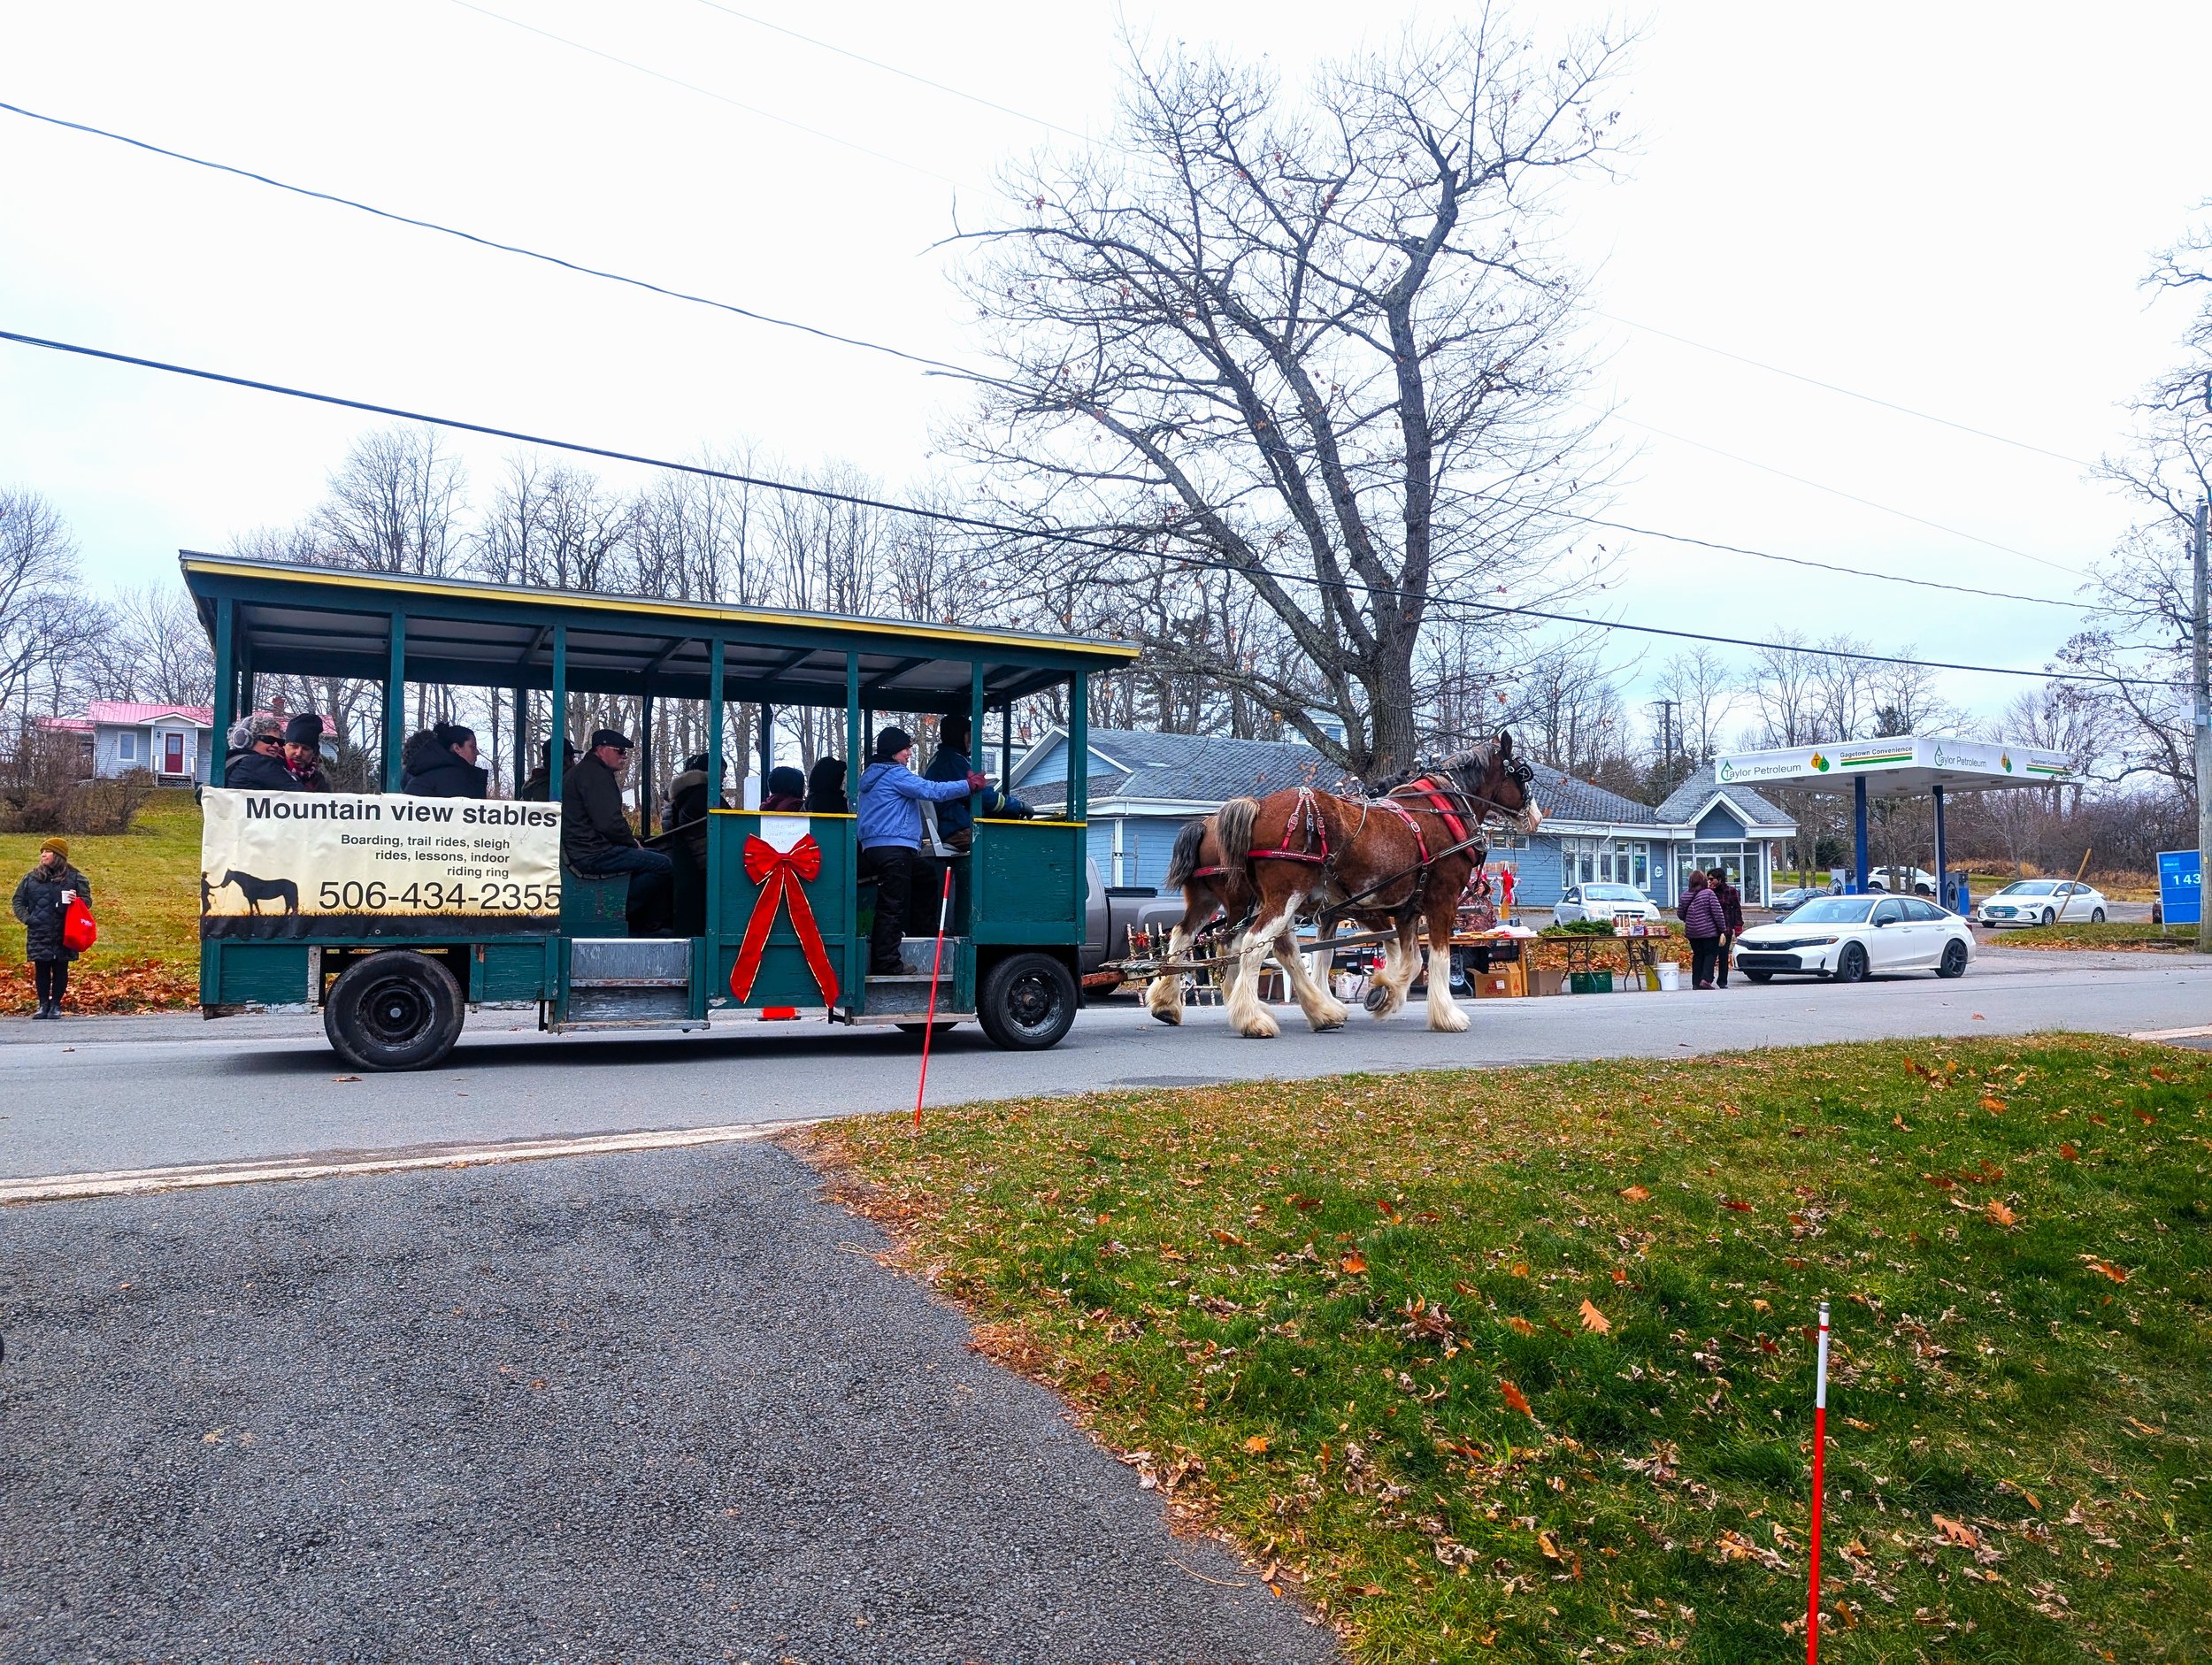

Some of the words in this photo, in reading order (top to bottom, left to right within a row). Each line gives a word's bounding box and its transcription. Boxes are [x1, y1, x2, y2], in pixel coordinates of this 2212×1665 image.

[1839, 750, 1870, 759] Gagetown
[1871, 746, 1913, 755] Convenience
[1937, 754, 1955, 766] Taylor
[1956, 756, 1987, 768] Petroleum
[1724, 768, 1752, 779] Taylor
[1754, 763, 1801, 775] Petroleum
[246, 797, 381, 821] Mountain
[390, 801, 454, 823] view
[462, 804, 557, 828] stables
[341, 833, 403, 848] Boarding,
[407, 835, 432, 847] trail
[435, 837, 470, 849] rides,
[473, 838, 511, 851] sleigh
[375, 850, 411, 862] rides,
[415, 850, 467, 863] lessons,
[471, 852, 511, 863] indoor
[447, 866, 482, 879] riding
[486, 867, 510, 879] ring
[319, 880, 560, 910] 506-434-2355
